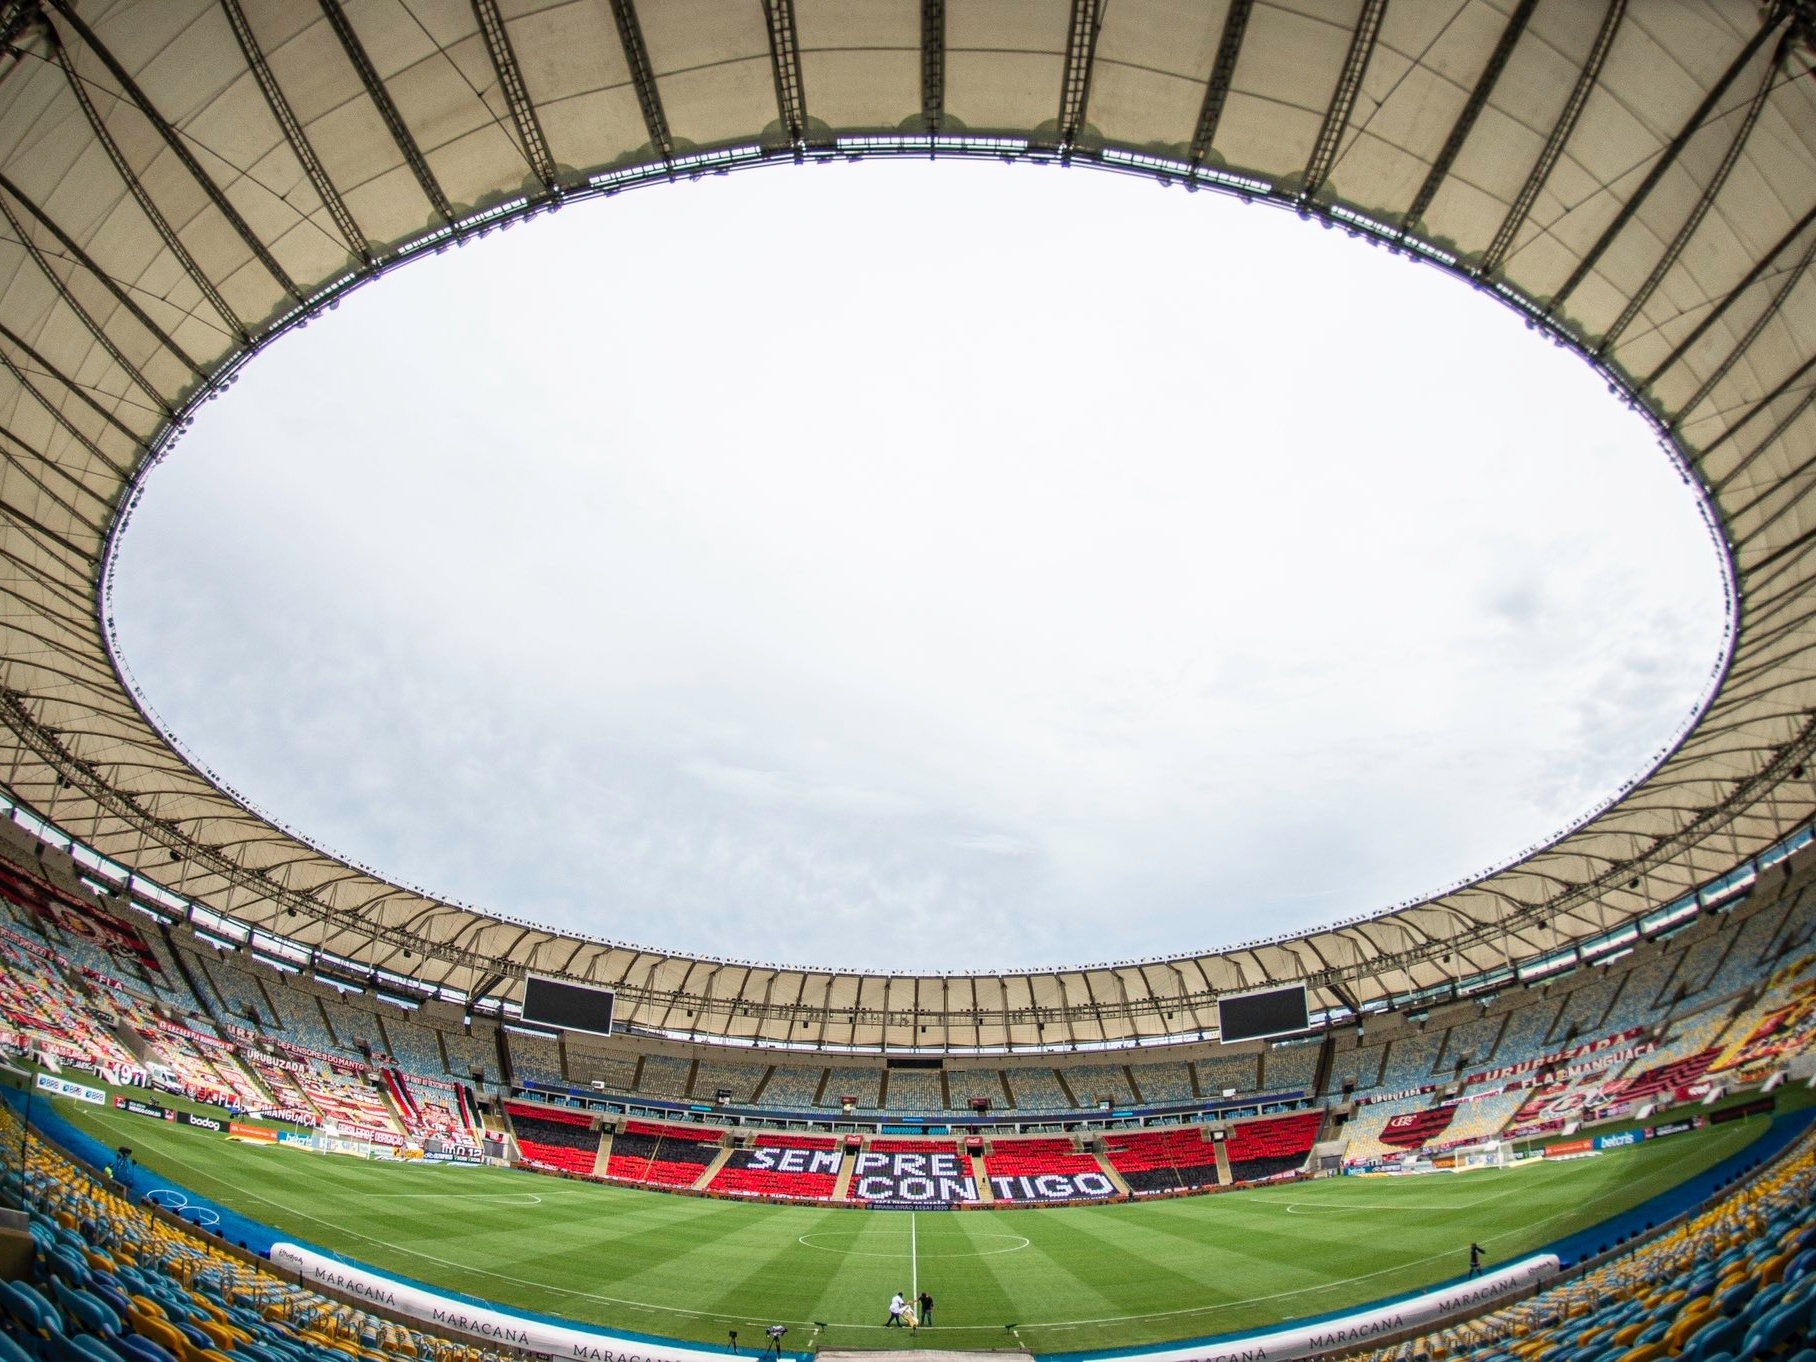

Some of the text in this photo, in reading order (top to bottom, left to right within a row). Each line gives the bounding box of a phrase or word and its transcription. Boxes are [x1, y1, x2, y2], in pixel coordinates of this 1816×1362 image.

[99, 974, 122, 991] FLA
[247, 1049, 305, 1074] URUBUZADA
[277, 1040, 328, 1060] DEFENSORES
[338, 1057, 365, 1071] MANTO
[1486, 1034, 1626, 1081] URUBUZADA
[190, 1113, 220, 1131] bodog
[1601, 1131, 1634, 1148] betcris
[315, 1267, 395, 1306] MARACANÃ
[1438, 1276, 1517, 1313] MARACANÃ
[432, 1308, 529, 1345] MARACANÃ
[1309, 1314, 1403, 1349] MARACANÃ
[573, 1344, 682, 1362] MARAC
